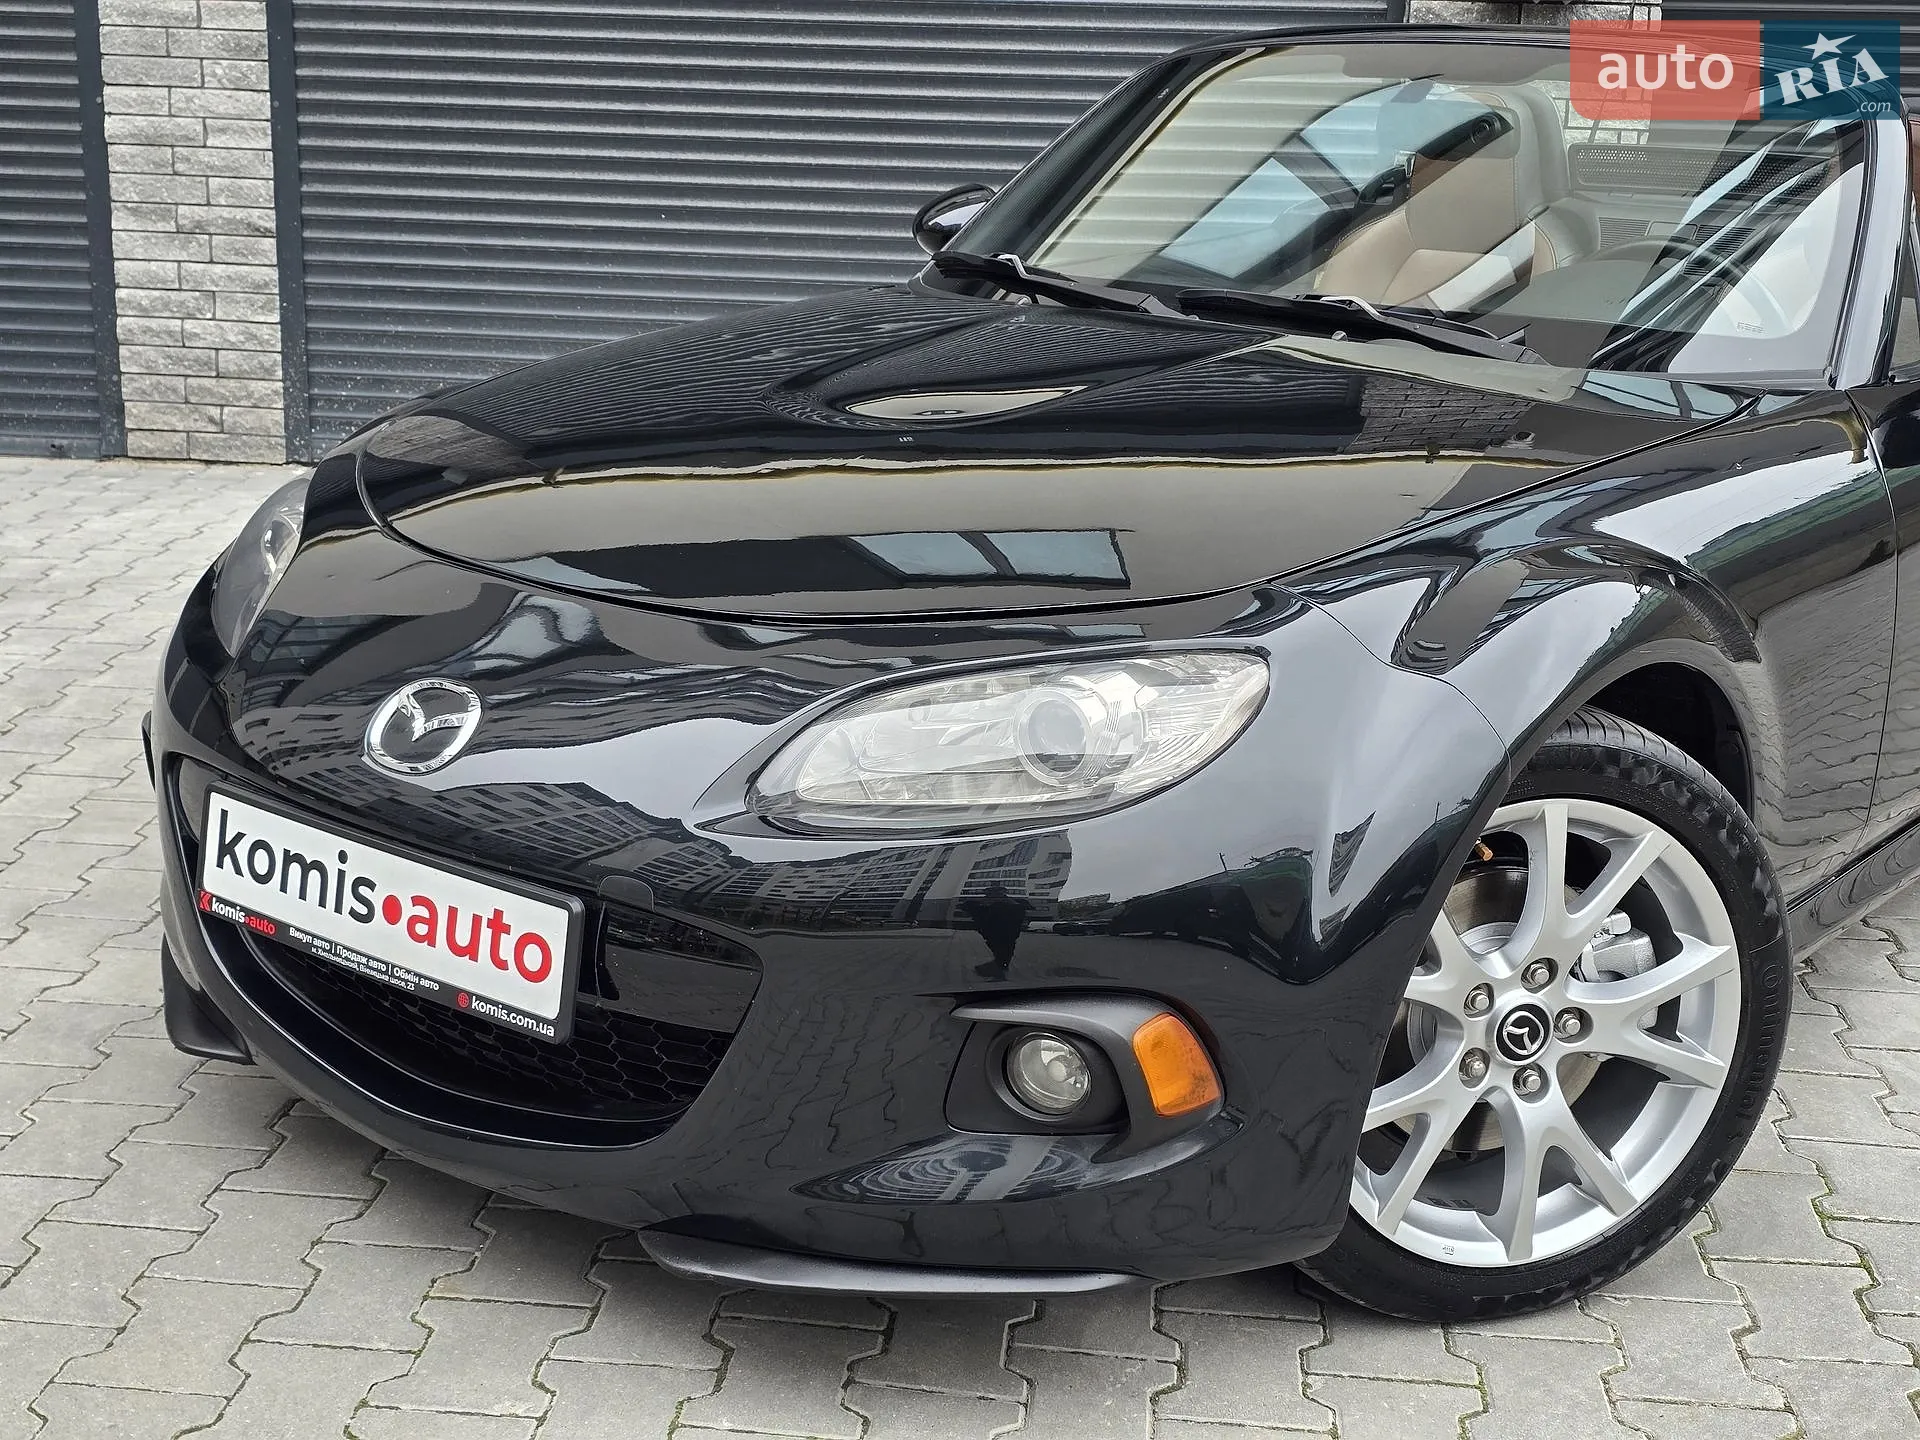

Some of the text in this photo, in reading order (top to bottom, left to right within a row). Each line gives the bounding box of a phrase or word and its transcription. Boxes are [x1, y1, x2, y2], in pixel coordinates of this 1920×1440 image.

[289, 927, 440, 991] Викуп авто Продаж авто Обмін авто
[407, 981, 415, 991] 23
[471, 996, 555, 1037] komis.com.ua
